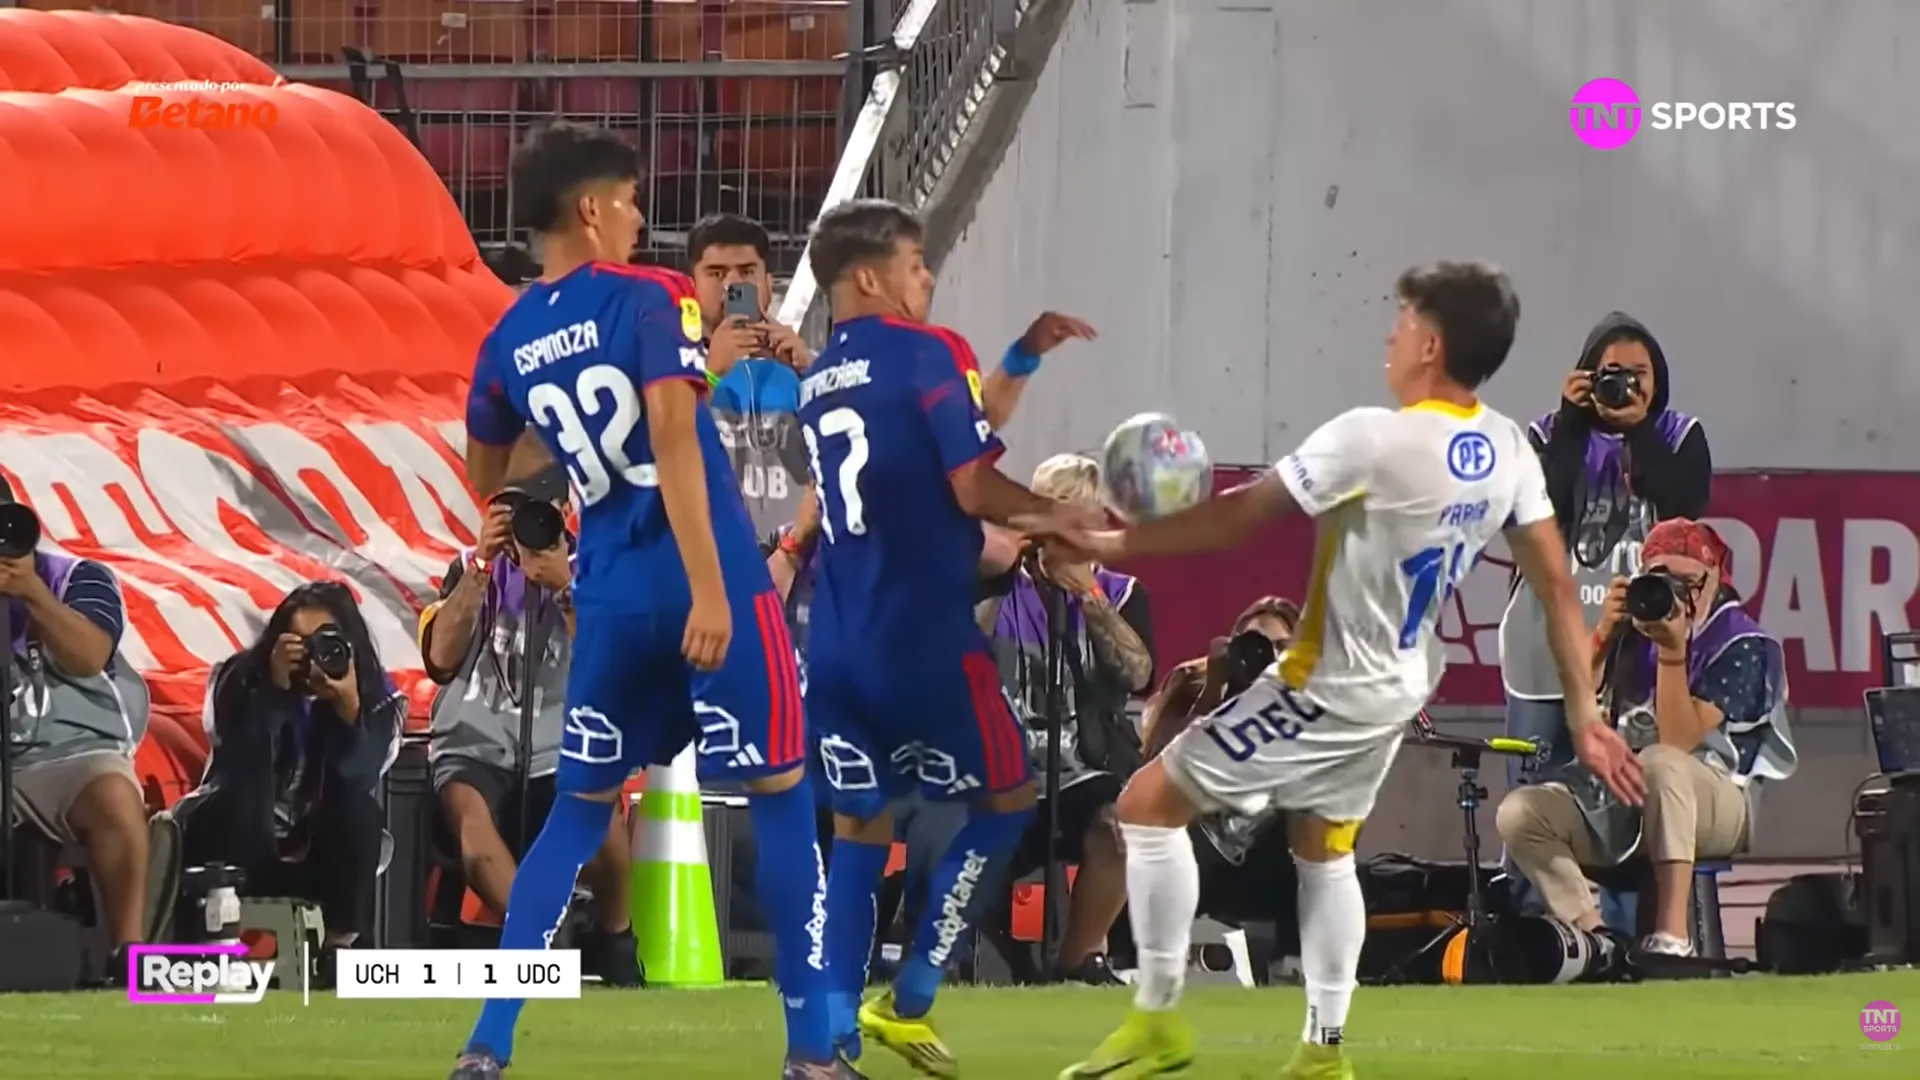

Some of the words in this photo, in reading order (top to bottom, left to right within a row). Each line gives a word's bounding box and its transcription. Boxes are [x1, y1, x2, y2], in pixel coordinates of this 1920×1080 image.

[513, 319, 600, 376] ESPINOZA
[527, 363, 661, 508] 32
[1458, 439, 1487, 471] PF
